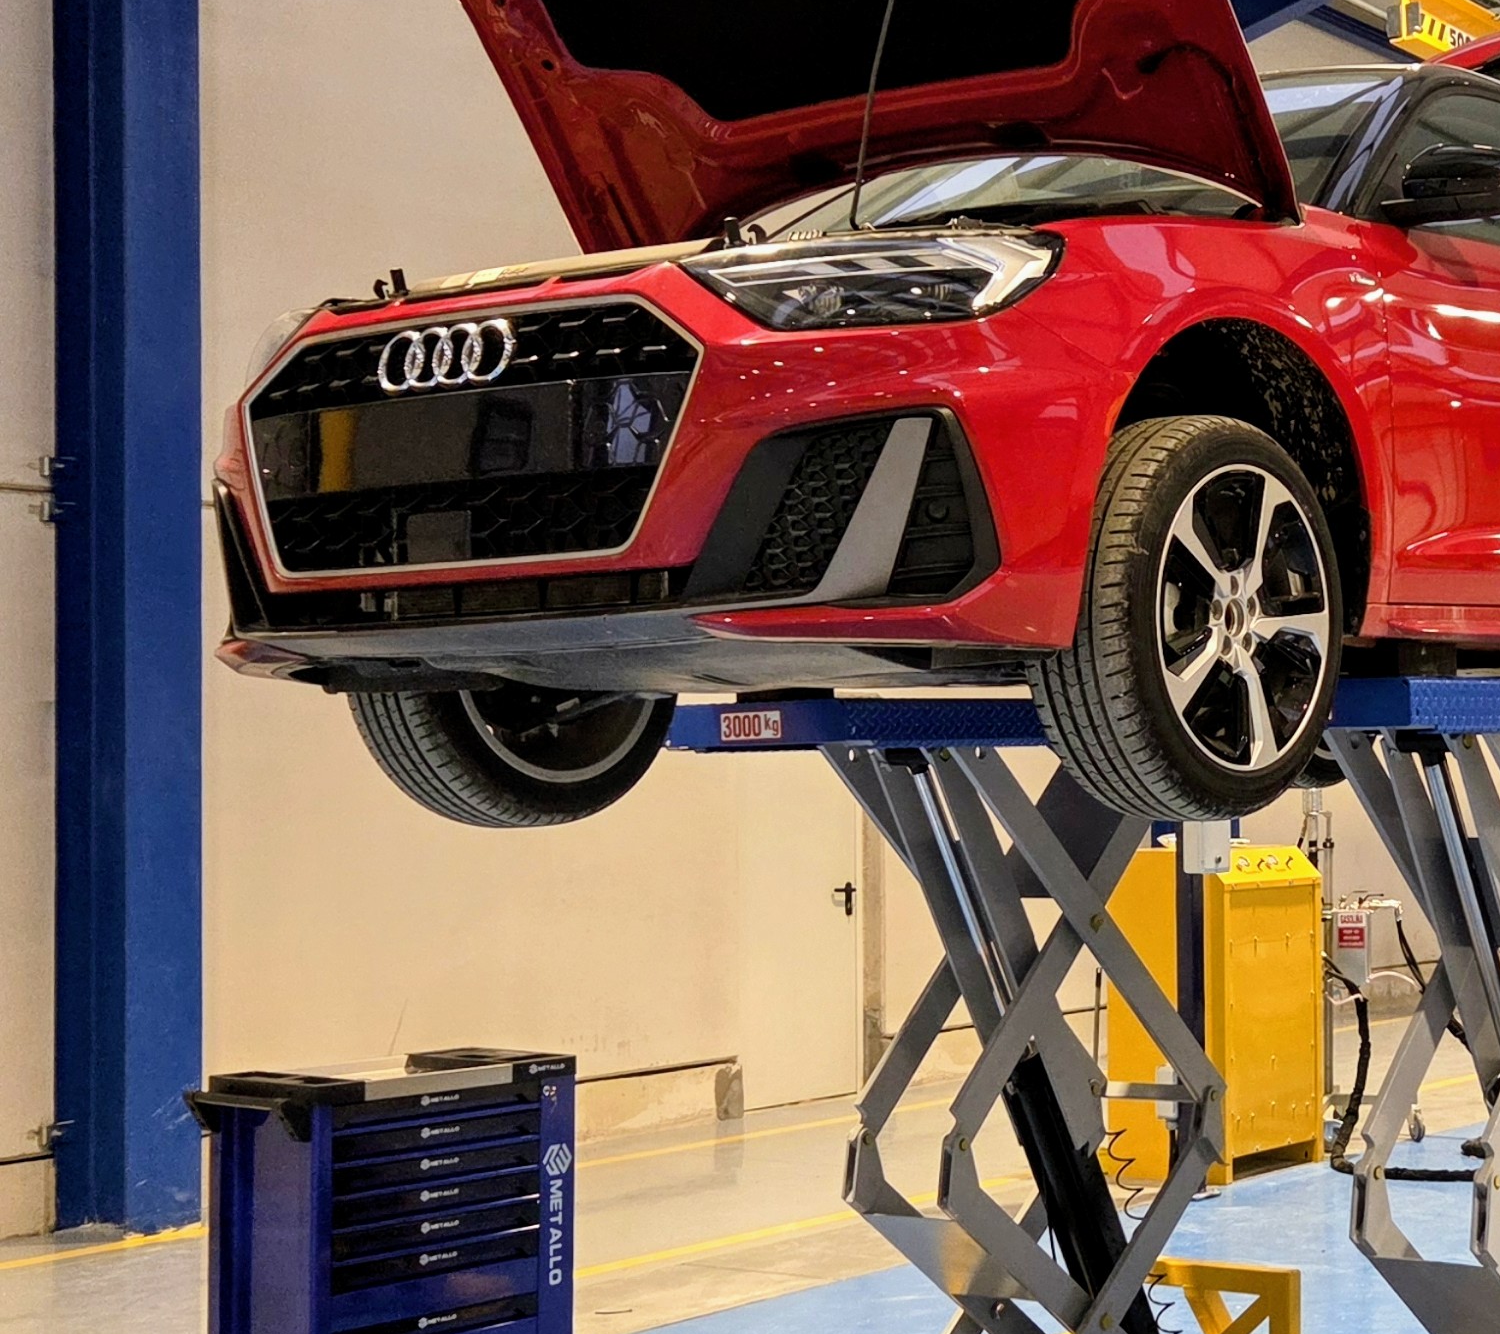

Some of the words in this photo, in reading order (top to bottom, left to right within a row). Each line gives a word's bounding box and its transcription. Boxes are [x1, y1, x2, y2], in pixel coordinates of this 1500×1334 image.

[723, 713, 762, 738] 3000
[763, 713, 779, 736] kg
[430, 1219, 460, 1230] METALLO
[547, 1178, 563, 1286] METALLO
